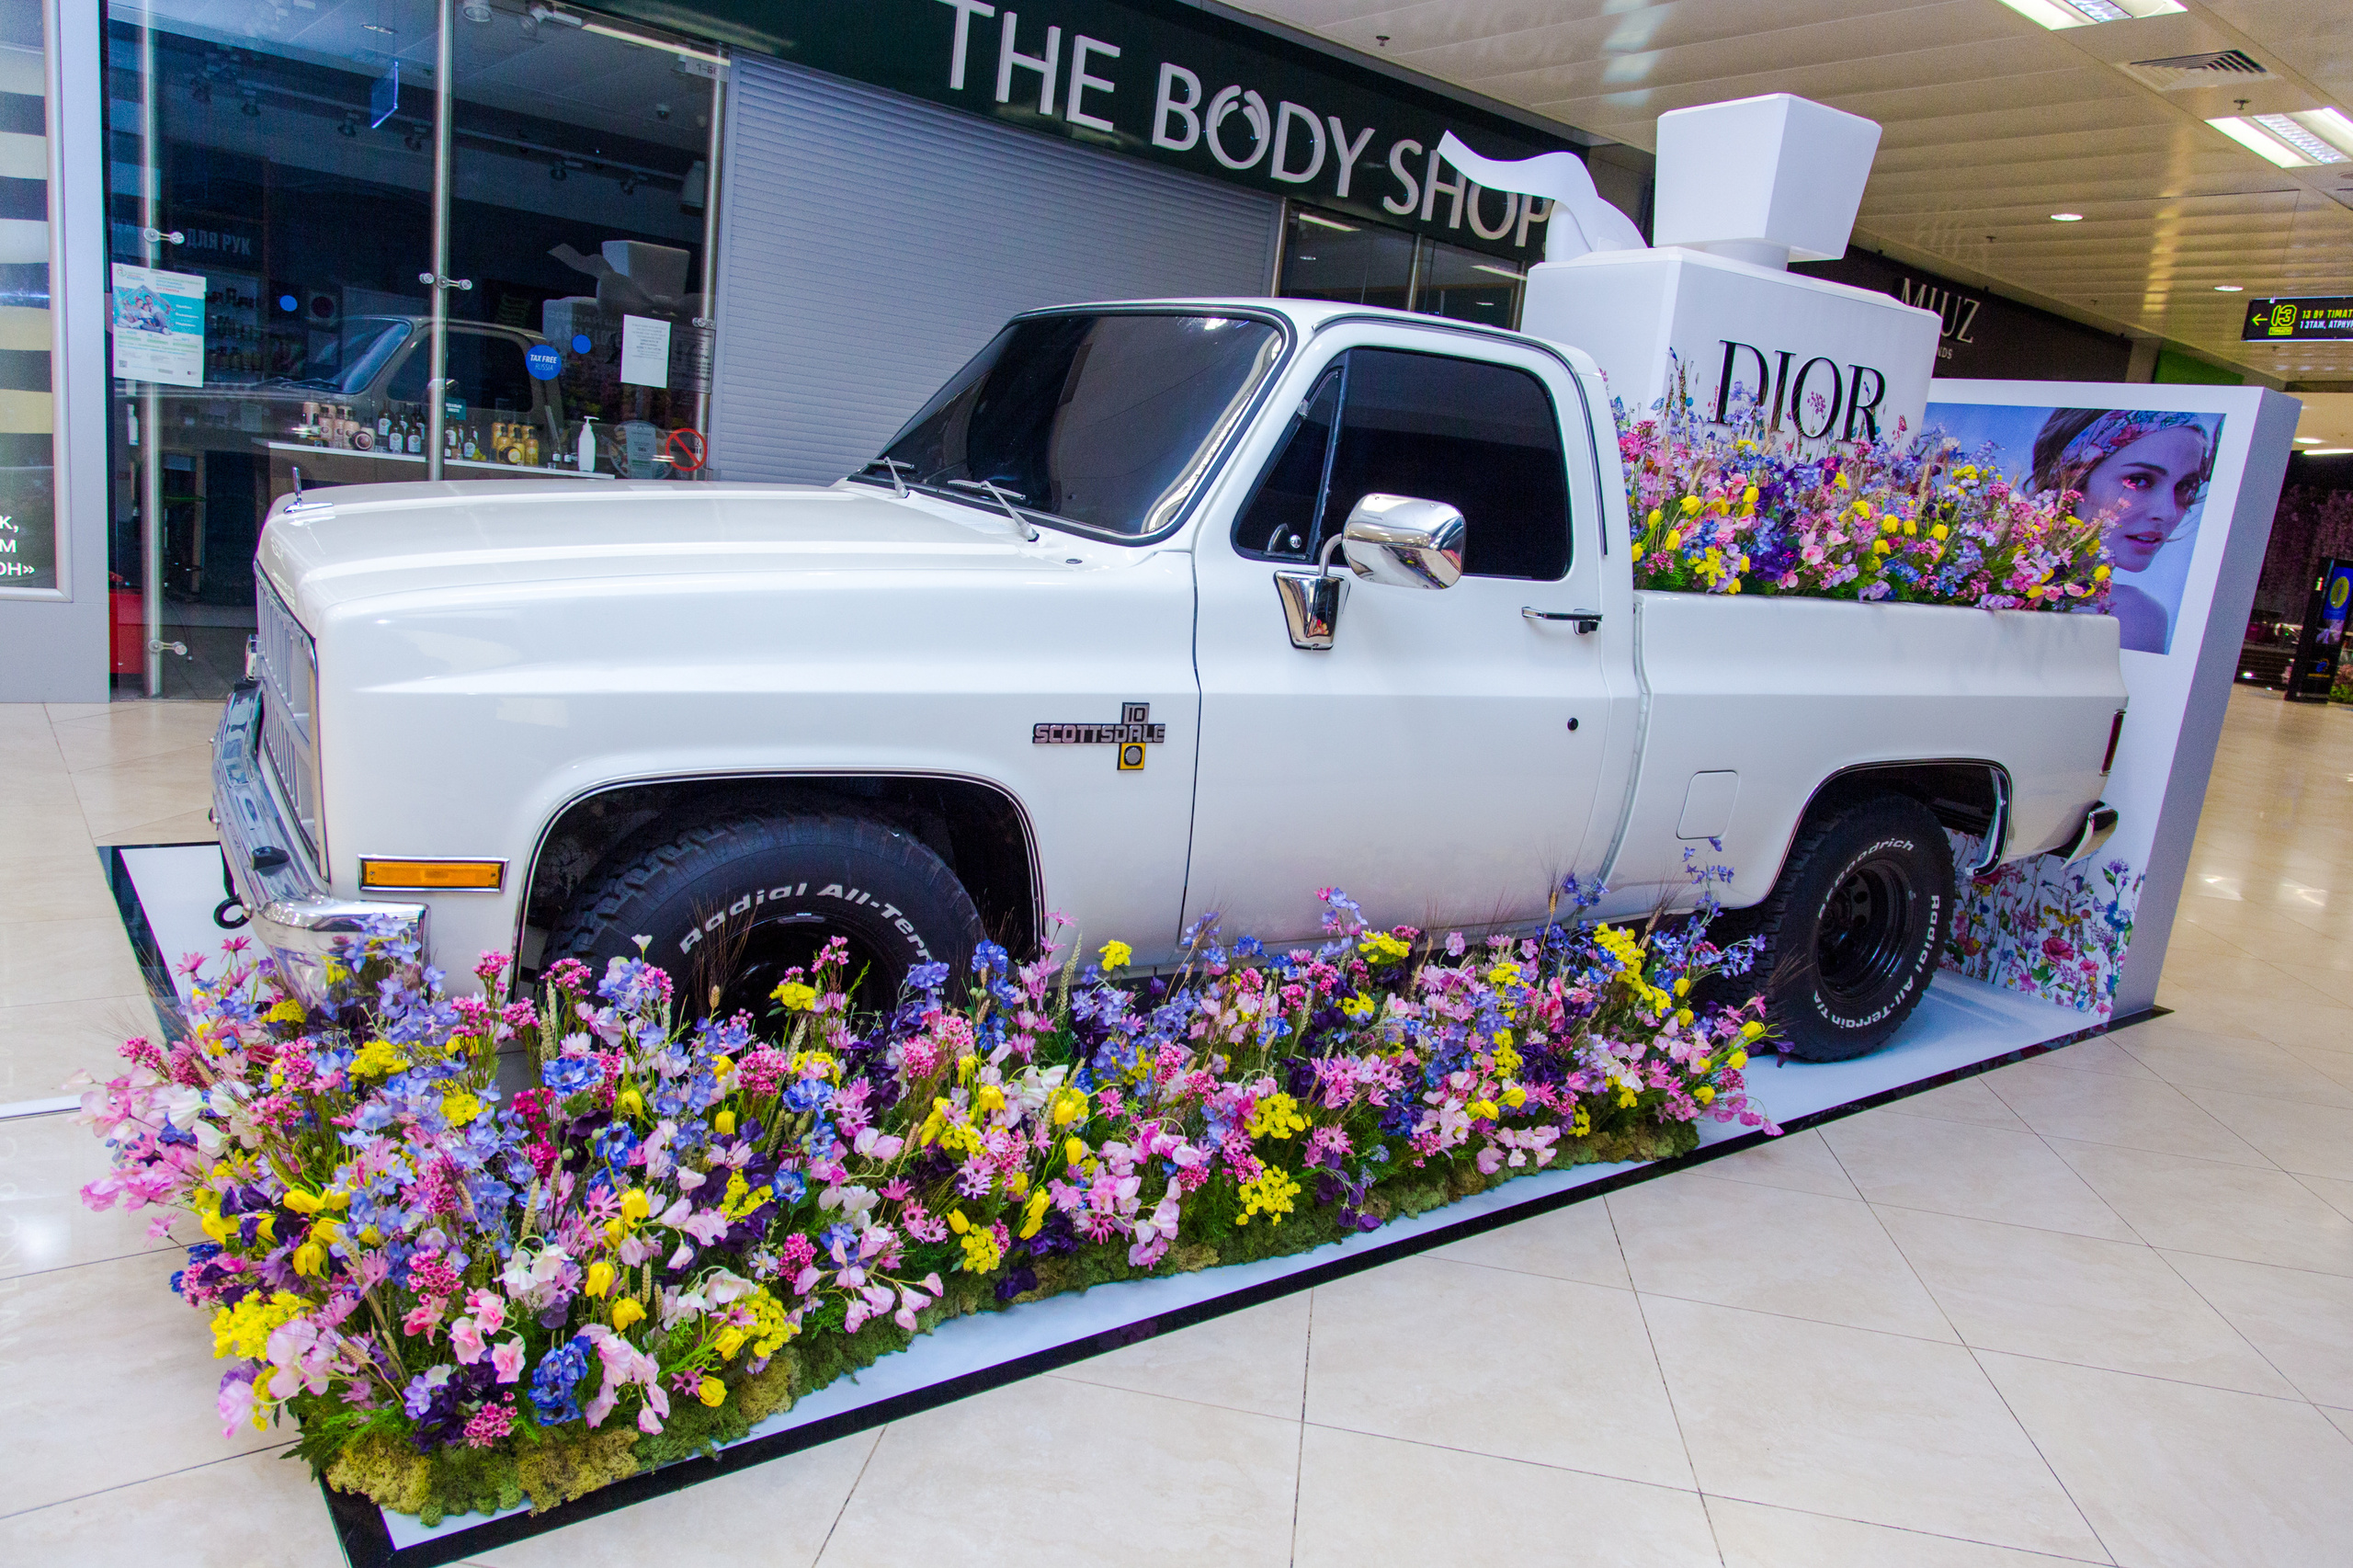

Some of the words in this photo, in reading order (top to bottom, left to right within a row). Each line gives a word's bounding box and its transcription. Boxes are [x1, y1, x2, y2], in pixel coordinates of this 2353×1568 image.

[945, 0, 1120, 132] THE
[1153, 62, 1375, 198] BODY
[1382, 139, 1555, 247] SHOP
[187, 228, 218, 250] ДЛЯ
[222, 233, 251, 255] РУК
[2302, 310, 2312, 319] 13
[2313, 310, 2325, 319] BY
[2326, 309, 2353, 318] TIMAT
[542, 356, 557, 364] FREE
[1708, 339, 1885, 446] DIOR
[1034, 724, 1165, 743] SCOTTSDALE
[1129, 708, 1145, 722] 10
[679, 882, 808, 955] Radial
[1915, 895, 1940, 974] Radial
[1831, 975, 1914, 1028] All-Terrain
